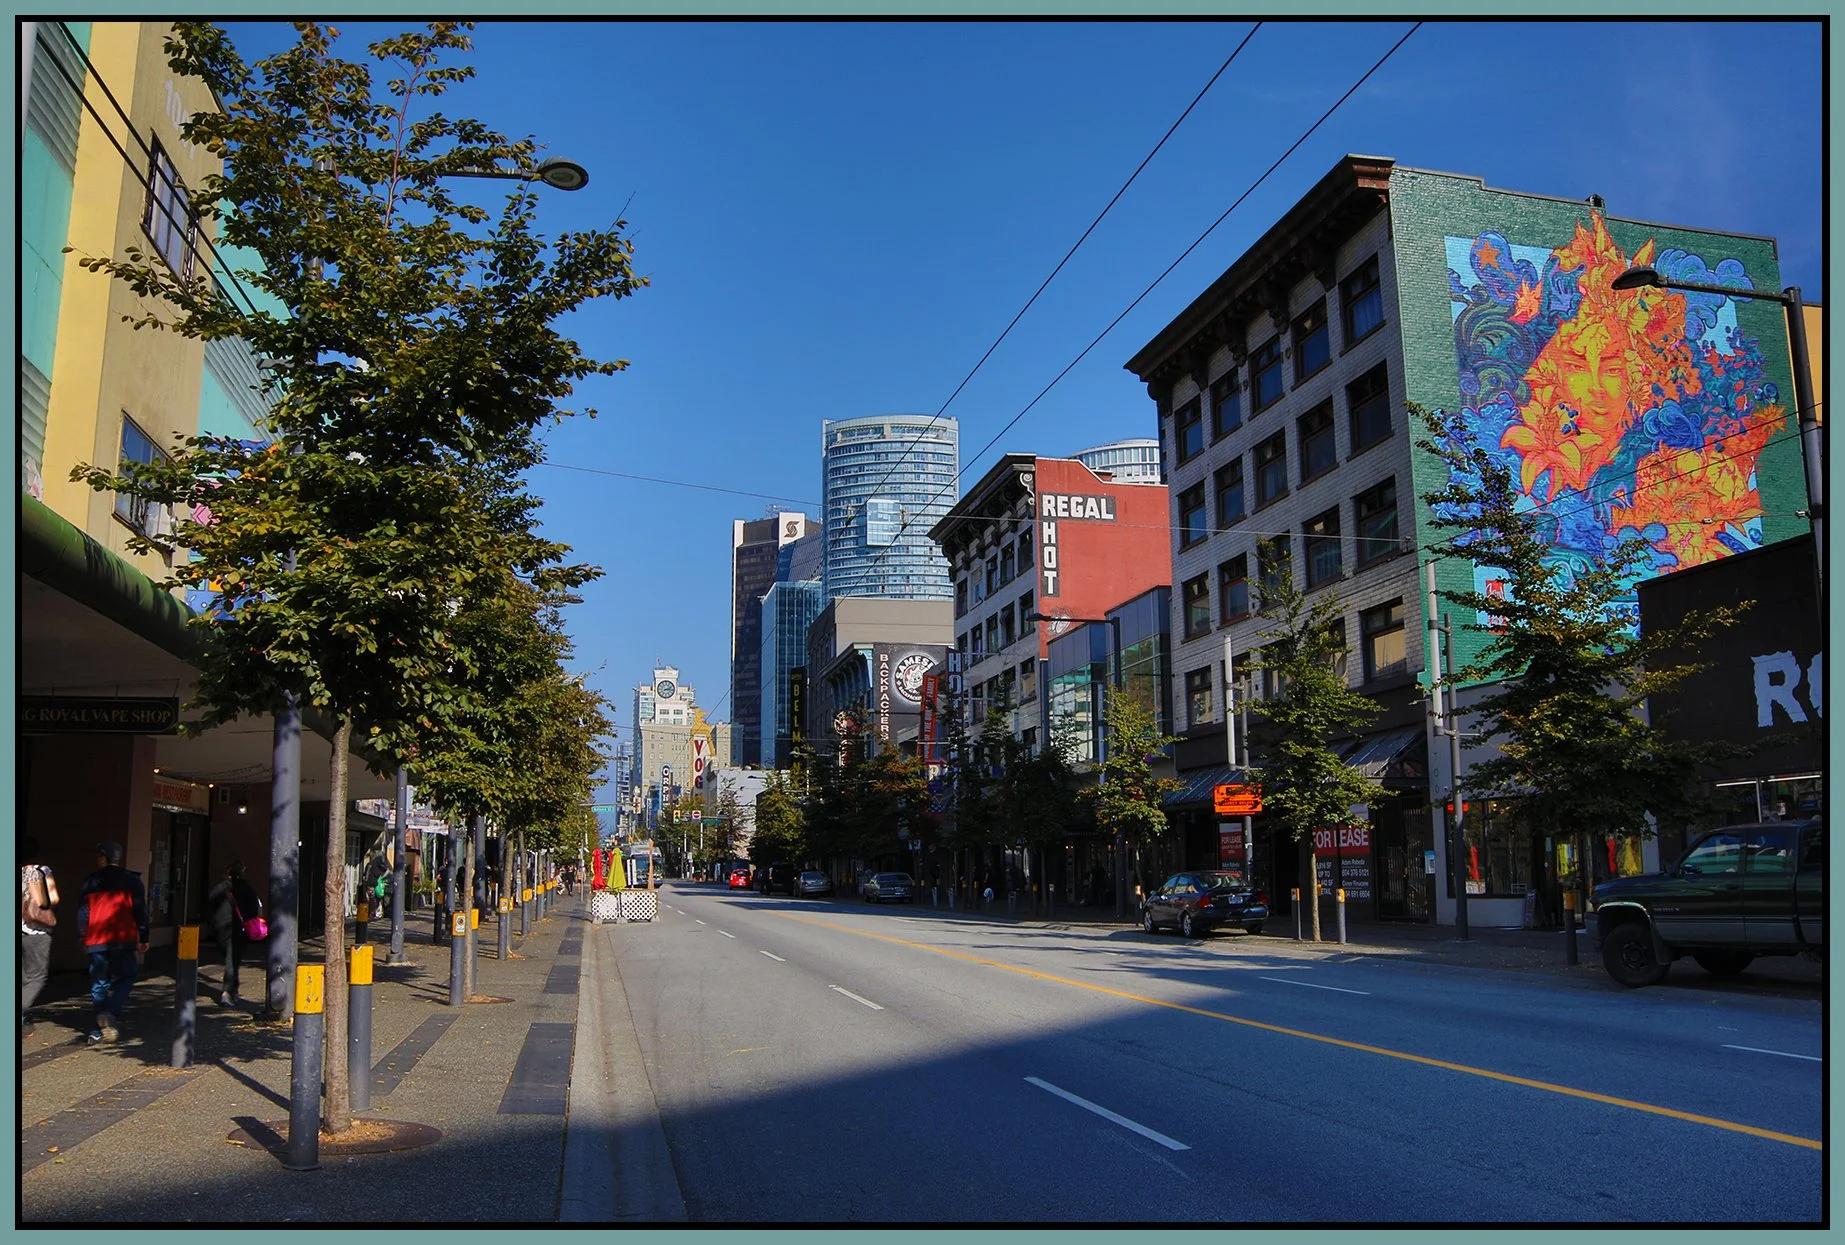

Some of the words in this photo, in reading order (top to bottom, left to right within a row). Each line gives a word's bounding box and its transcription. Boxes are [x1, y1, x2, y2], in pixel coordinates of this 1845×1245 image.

[1042, 495, 1114, 519] REGAL
[1043, 522, 1057, 594] HOT
[39, 708, 91, 722] ROYAL
[92, 708, 129, 723] VAPE
[131, 709, 171, 723] SHOP
[880, 654, 889, 741] BACKPACKERS
[792, 684, 801, 772] BELMON
[694, 740, 704, 789] VOG
[1221, 836, 1230, 844] FOR
[1230, 835, 1242, 844] LEASE
